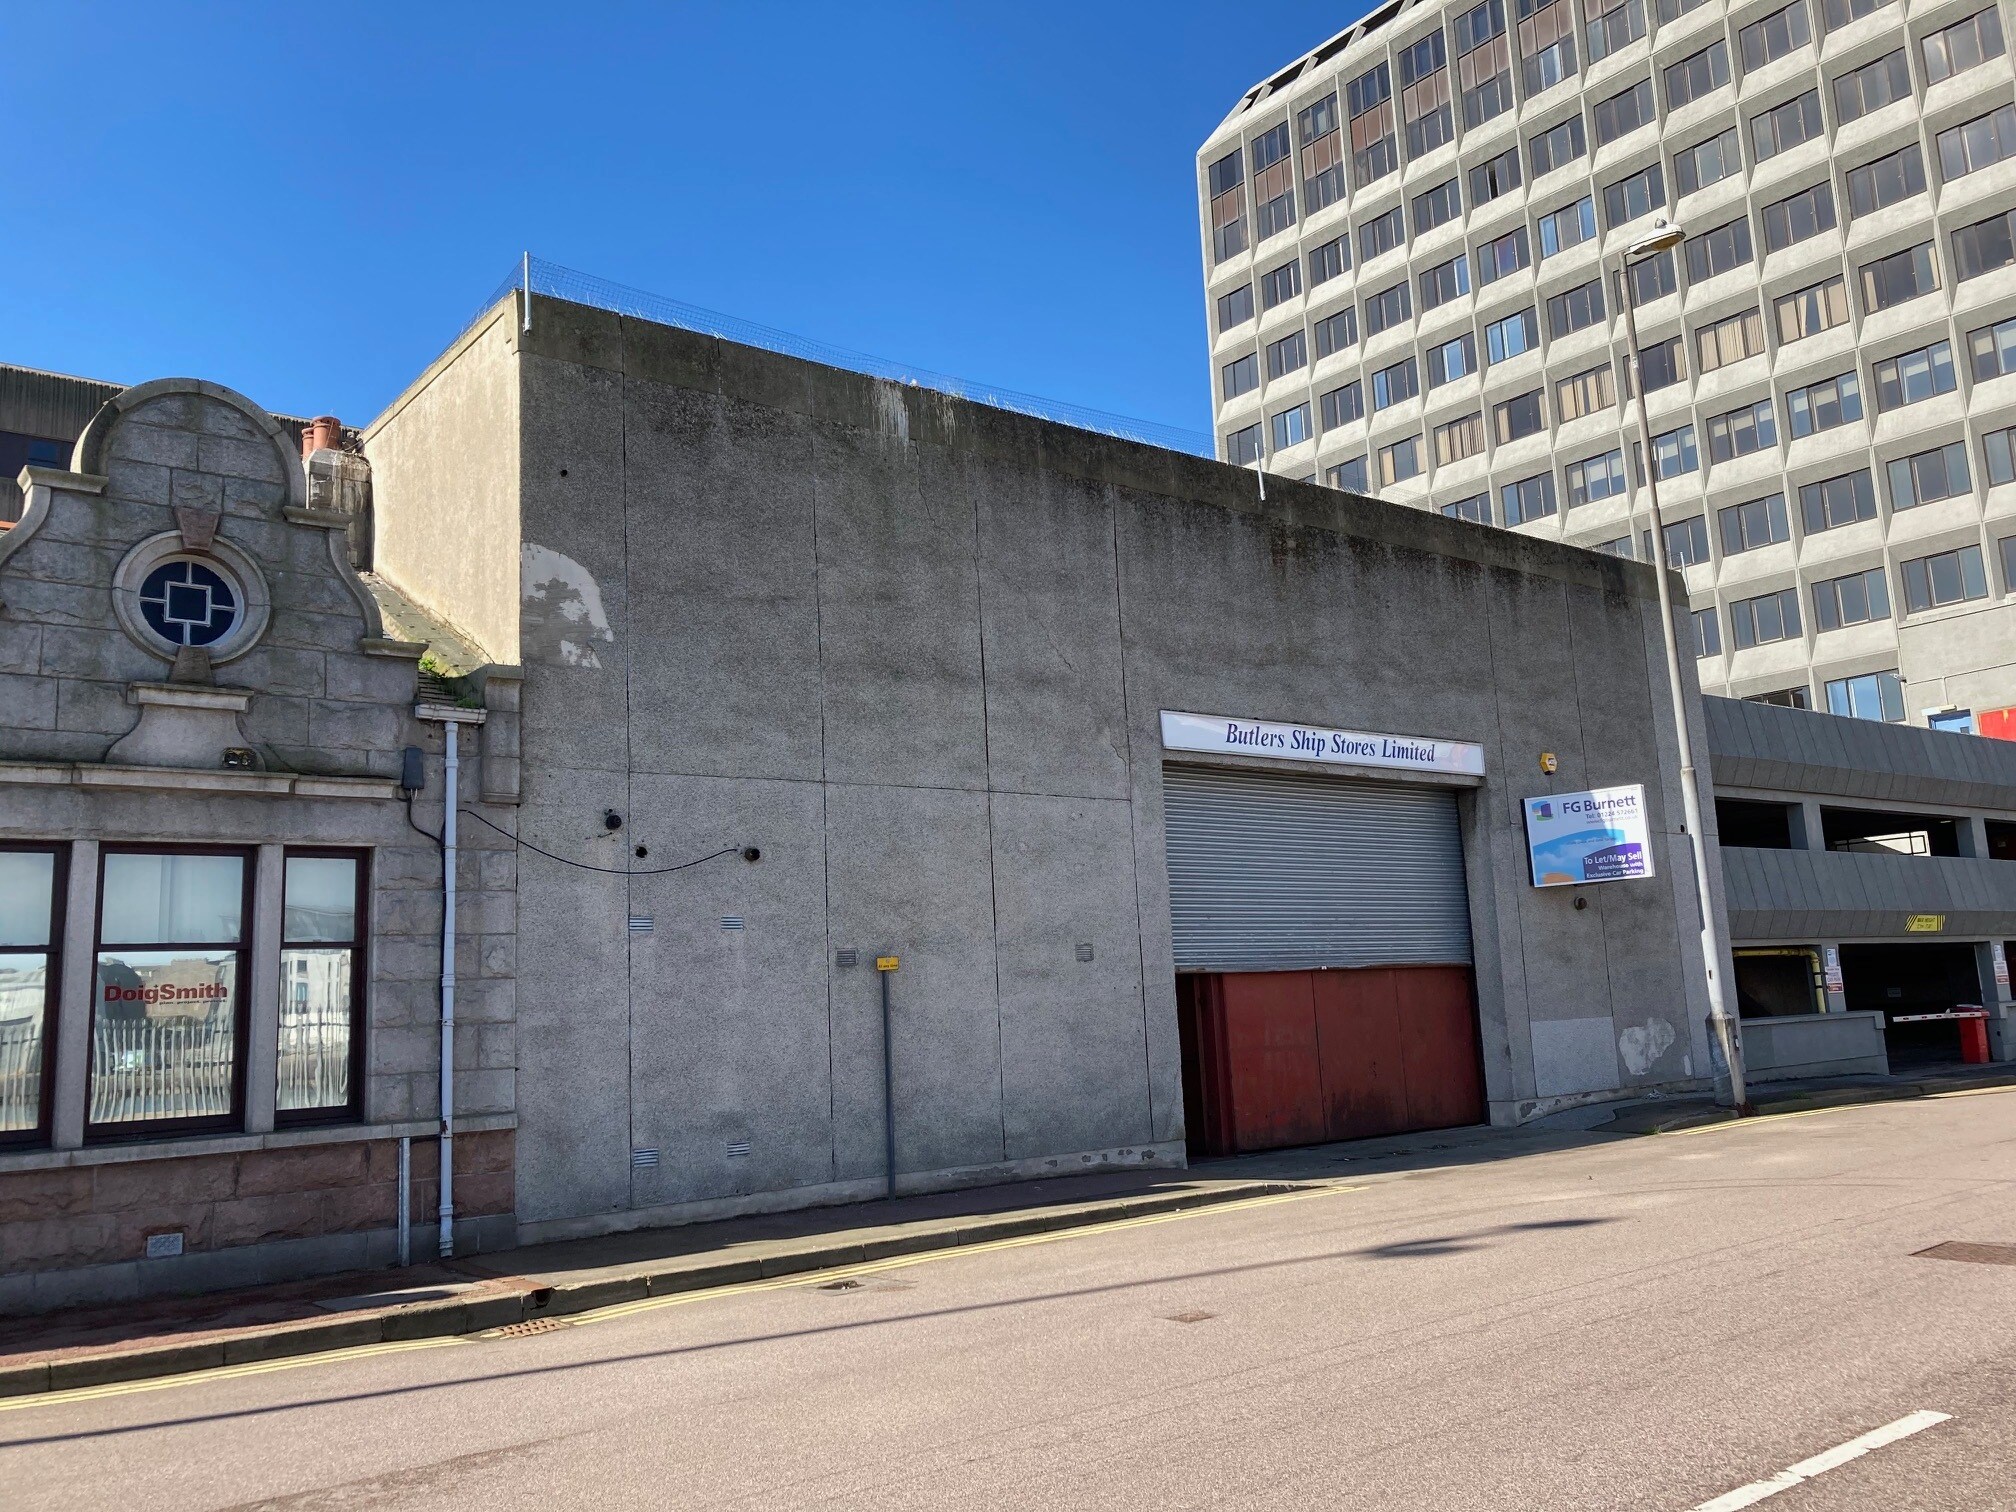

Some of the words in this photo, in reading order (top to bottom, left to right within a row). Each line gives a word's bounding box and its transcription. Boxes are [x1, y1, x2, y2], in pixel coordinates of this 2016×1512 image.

[1225, 722, 1285, 748] Butlers
[1290, 729, 1326, 757] Ship
[1331, 733, 1376, 757] Stores
[1381, 738, 1436, 762] Limited
[1562, 801, 1582, 814] FG
[1583, 795, 1637, 811] Burnett
[1594, 854, 1627, 864] Let/May
[1627, 851, 1642, 860] Sell
[104, 982, 228, 1005] DoigSmith
